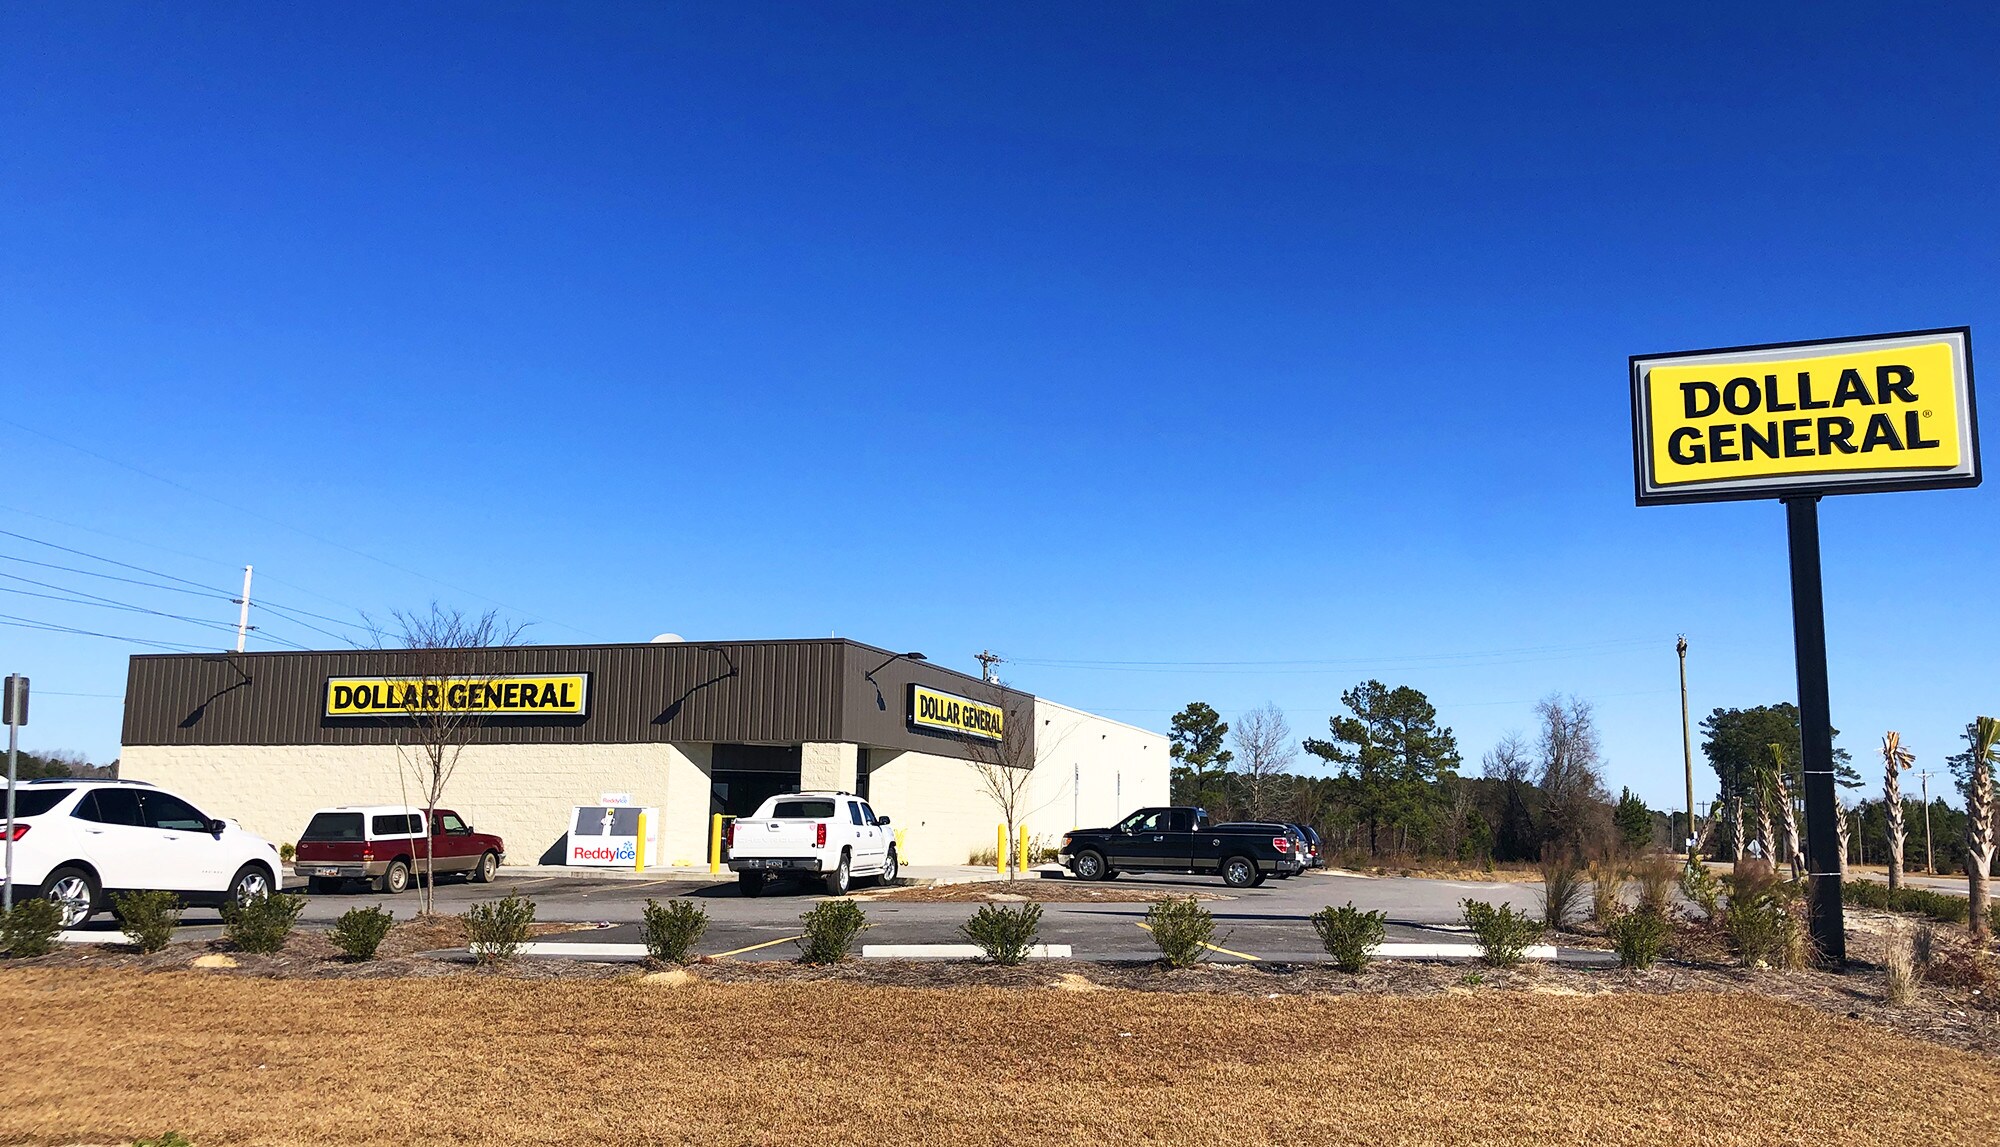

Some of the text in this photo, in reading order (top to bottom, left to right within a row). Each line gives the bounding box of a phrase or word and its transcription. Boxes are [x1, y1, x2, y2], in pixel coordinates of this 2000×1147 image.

[1680, 364, 1919, 419] DOLLAR
[1668, 410, 1940, 465] GENERAL
[334, 682, 576, 709] DOLLAR GENERAL
[920, 694, 1002, 734] DOLLAR GENERAL
